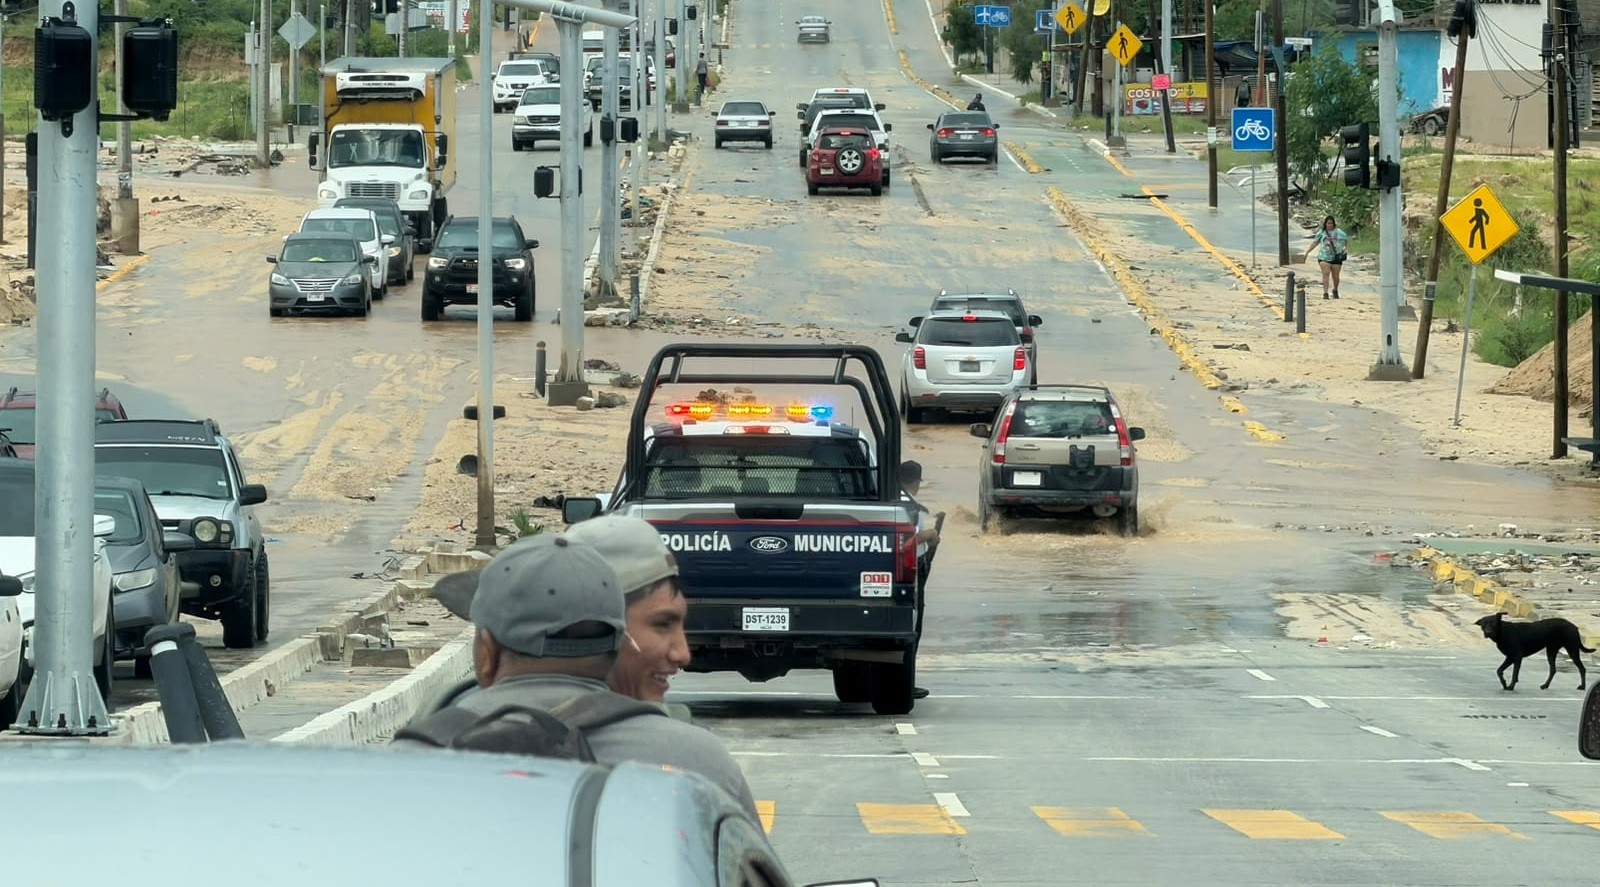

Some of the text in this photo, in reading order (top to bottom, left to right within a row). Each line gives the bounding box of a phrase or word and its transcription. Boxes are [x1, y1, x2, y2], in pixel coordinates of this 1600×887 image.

[660, 530, 892, 553] POLICÍA MUNICIPAL
[864, 575, 888, 583] 911
[745, 614, 786, 624] DST-1239
